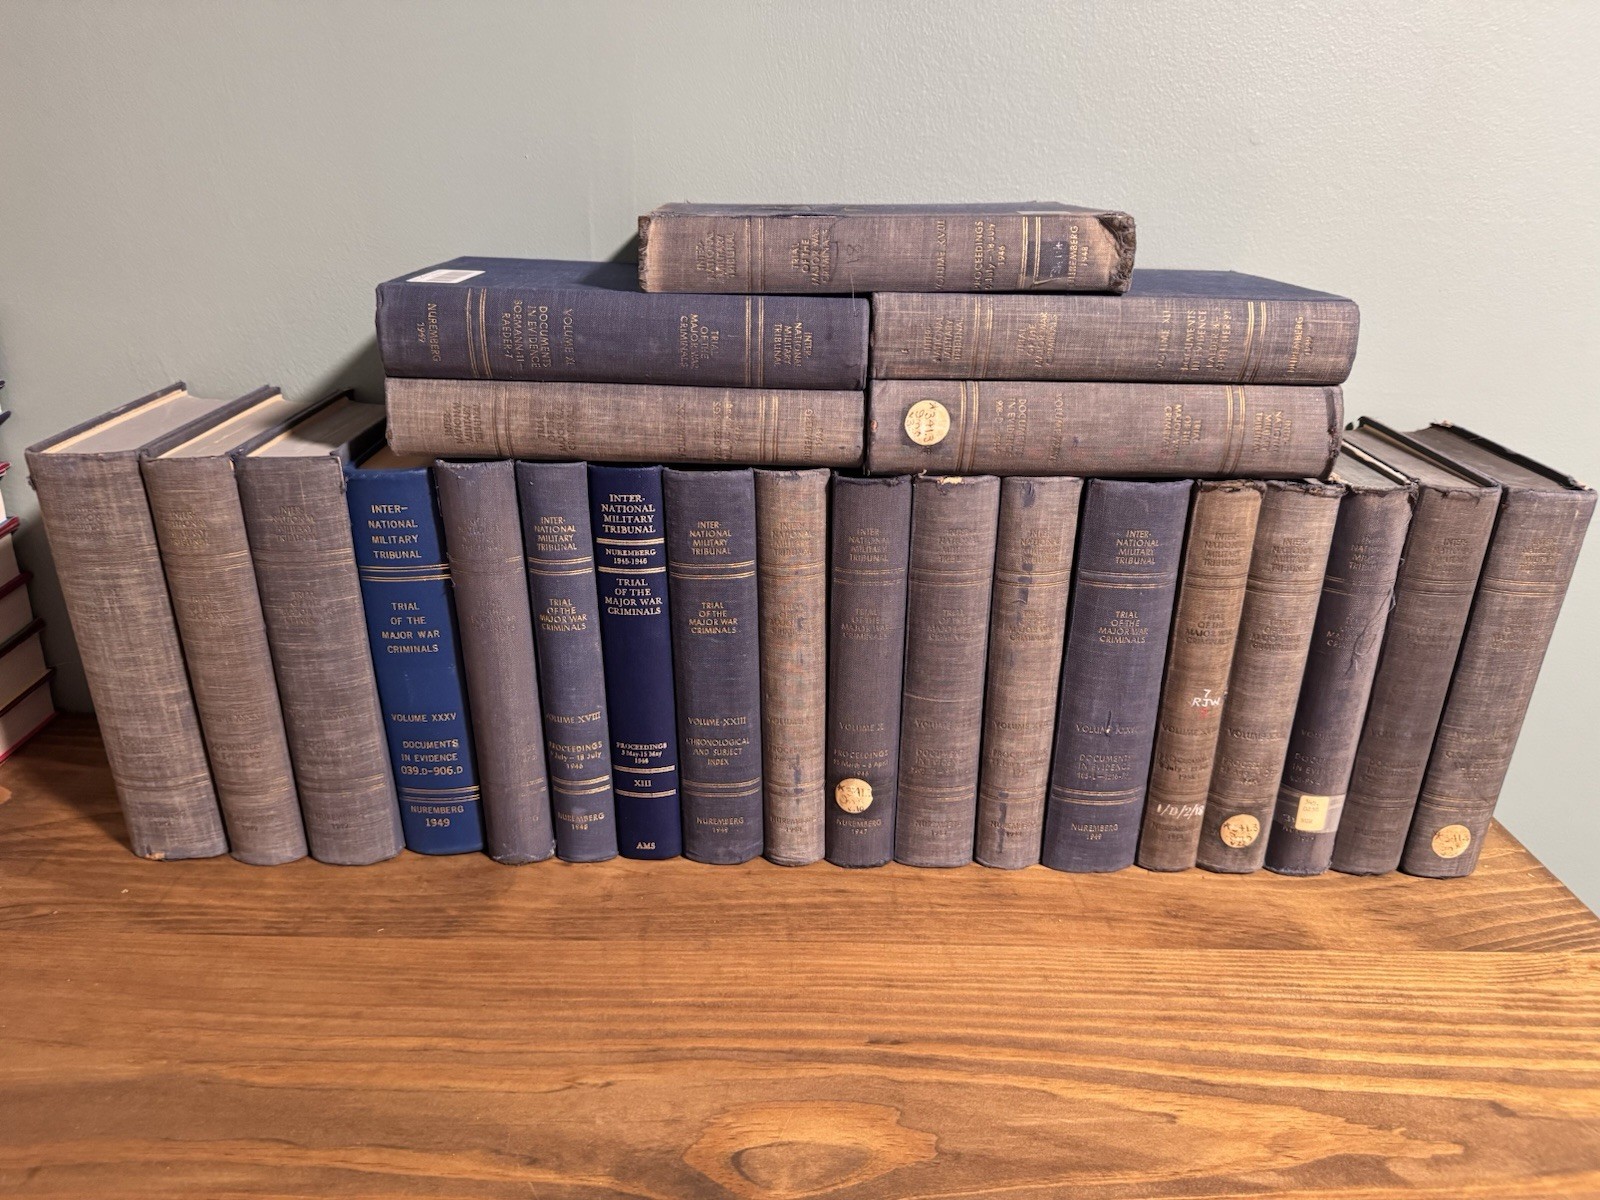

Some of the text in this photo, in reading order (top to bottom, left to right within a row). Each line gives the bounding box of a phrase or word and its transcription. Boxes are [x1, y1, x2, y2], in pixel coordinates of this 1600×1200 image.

[792, 243, 800, 270] TRIAL
[801, 240, 810, 272] OF THE
[811, 250, 820, 285] MAJOR
[428, 303, 441, 362] NUREMBERG
[563, 308, 576, 352] VOLUME
[689, 314, 699, 348] MAJOR
[1193, 310, 1206, 356] EVIDENCE
[501, 313, 512, 358] RAEDER-7
[528, 306, 541, 368] IN EVIDENCE
[539, 306, 551, 368] DOCUMENTS
[679, 315, 689, 368] CRIMINALS
[700, 326, 709, 359] OF THE
[710, 330, 719, 355] TRIAL
[773, 323, 783, 367] TRIBUNAL
[783, 326, 792, 365] MILITARY
[794, 322, 803, 367] NATIONAL
[609, 494, 646, 502] INTER-
[371, 504, 408, 514] INTER-
[601, 504, 656, 513] NATIONAL
[541, 516, 566, 524] INTER-
[603, 514, 654, 523] MILITARY
[368, 519, 418, 529] NATIONAL
[602, 524, 656, 533] TRIBUNAL
[697, 521, 722, 529] INTER-
[535, 525, 576, 533] NATIONAL
[538, 534, 574, 542] MILITARY
[690, 530, 732, 538] NATIONAL
[1126, 530, 1151, 538] INTER-
[372, 534, 419, 544] MILITARY
[1116, 538, 1159, 547] NATIONAL
[537, 543, 577, 552] TRIBUNAL
[605, 548, 656, 556] NUREMBERG
[1119, 548, 1154, 556] MILITARY
[373, 550, 422, 559] TRIBUNAL
[613, 557, 648, 565] 1945-1946
[1115, 556, 1155, 565] TRIBUNAL
[616, 578, 648, 586] TRIAL
[615, 588, 652, 596] OF THE
[391, 602, 420, 611] TRIAL
[605, 597, 663, 608] MAJOR WAR
[547, 607, 558, 615] OF
[608, 607, 661, 616] CRIMINALS
[390, 616, 426, 625] OF THE
[540, 614, 588, 623] MAJOR WAR
[1110, 619, 1140, 627] OF THE
[542, 623, 586, 632] CRIMINALS
[1098, 627, 1148, 636] MAJOR WAR
[381, 630, 440, 640] MAJOR WAR
[1100, 635, 1145, 644] CRIMINALS
[387, 644, 439, 654] CRIMINALS
[1204, 689, 1212, 698] 7
[1192, 698, 1221, 707] RJW
[391, 712, 457, 722] VOLUME XXXV
[578, 711, 601, 723] XVIII
[688, 716, 746, 726] VOLUME XXIII
[403, 739, 459, 749] DOCUMENTS
[616, 742, 667, 750] PROCEEDINGS
[587, 751, 602, 760] July
[693, 748, 742, 756] AND SUBJECT
[401, 753, 458, 762] IN EVIDENCE
[410, 805, 464, 814] NUREMBERG
[425, 818, 450, 827] 1949
[696, 817, 744, 825] NUREMBERG
[1071, 822, 1118, 832] NUREMBERG
[636, 842, 656, 850] AMS
